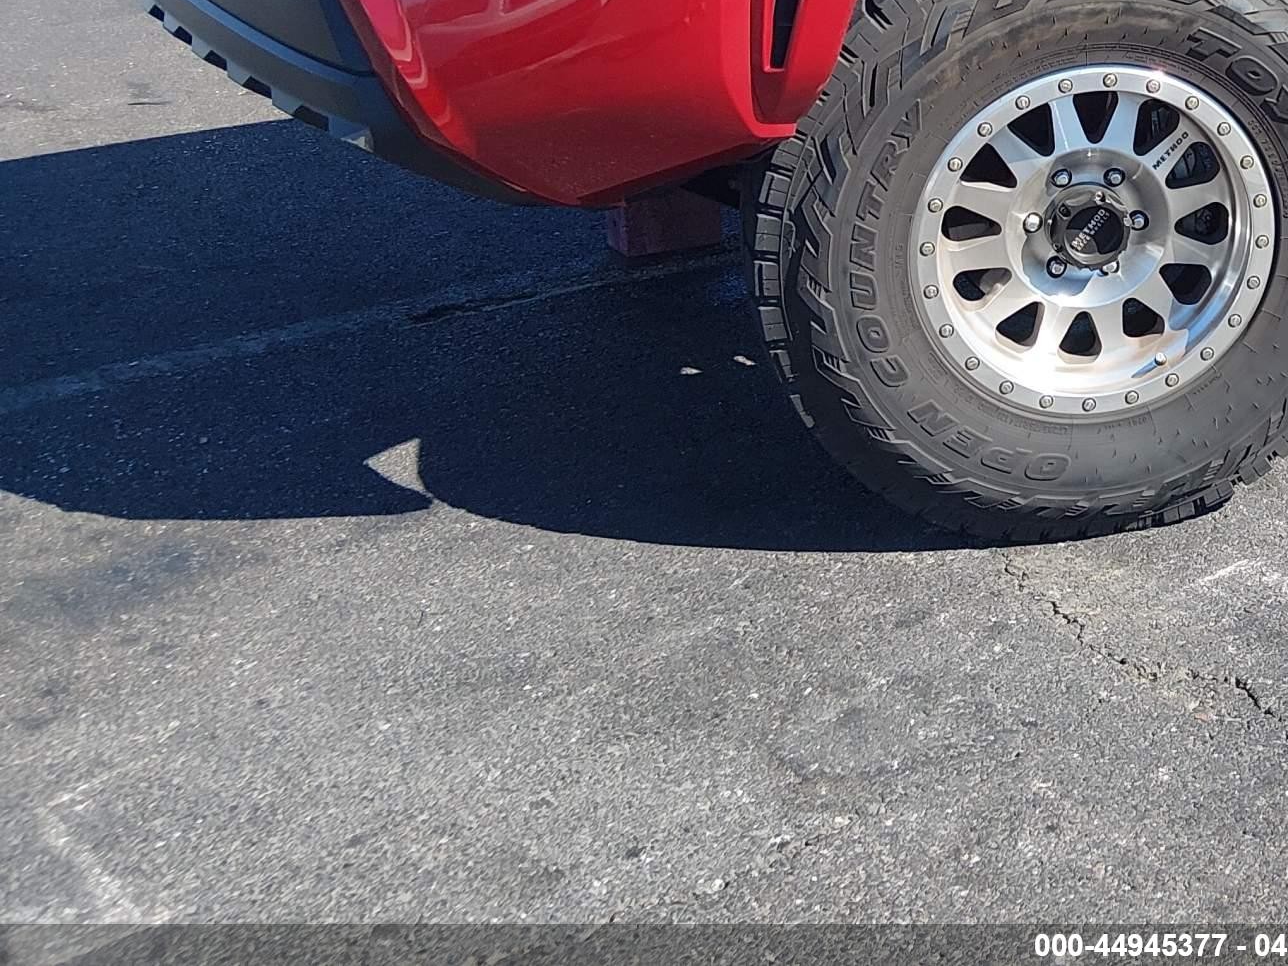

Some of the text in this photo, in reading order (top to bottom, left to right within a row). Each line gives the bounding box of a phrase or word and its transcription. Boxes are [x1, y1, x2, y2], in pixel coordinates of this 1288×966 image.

[1152, 131, 1189, 170] METHOD
[849, 98, 923, 388] COUNTRY
[1071, 209, 1106, 248] METHOD
[906, 399, 1072, 482] OPEN
